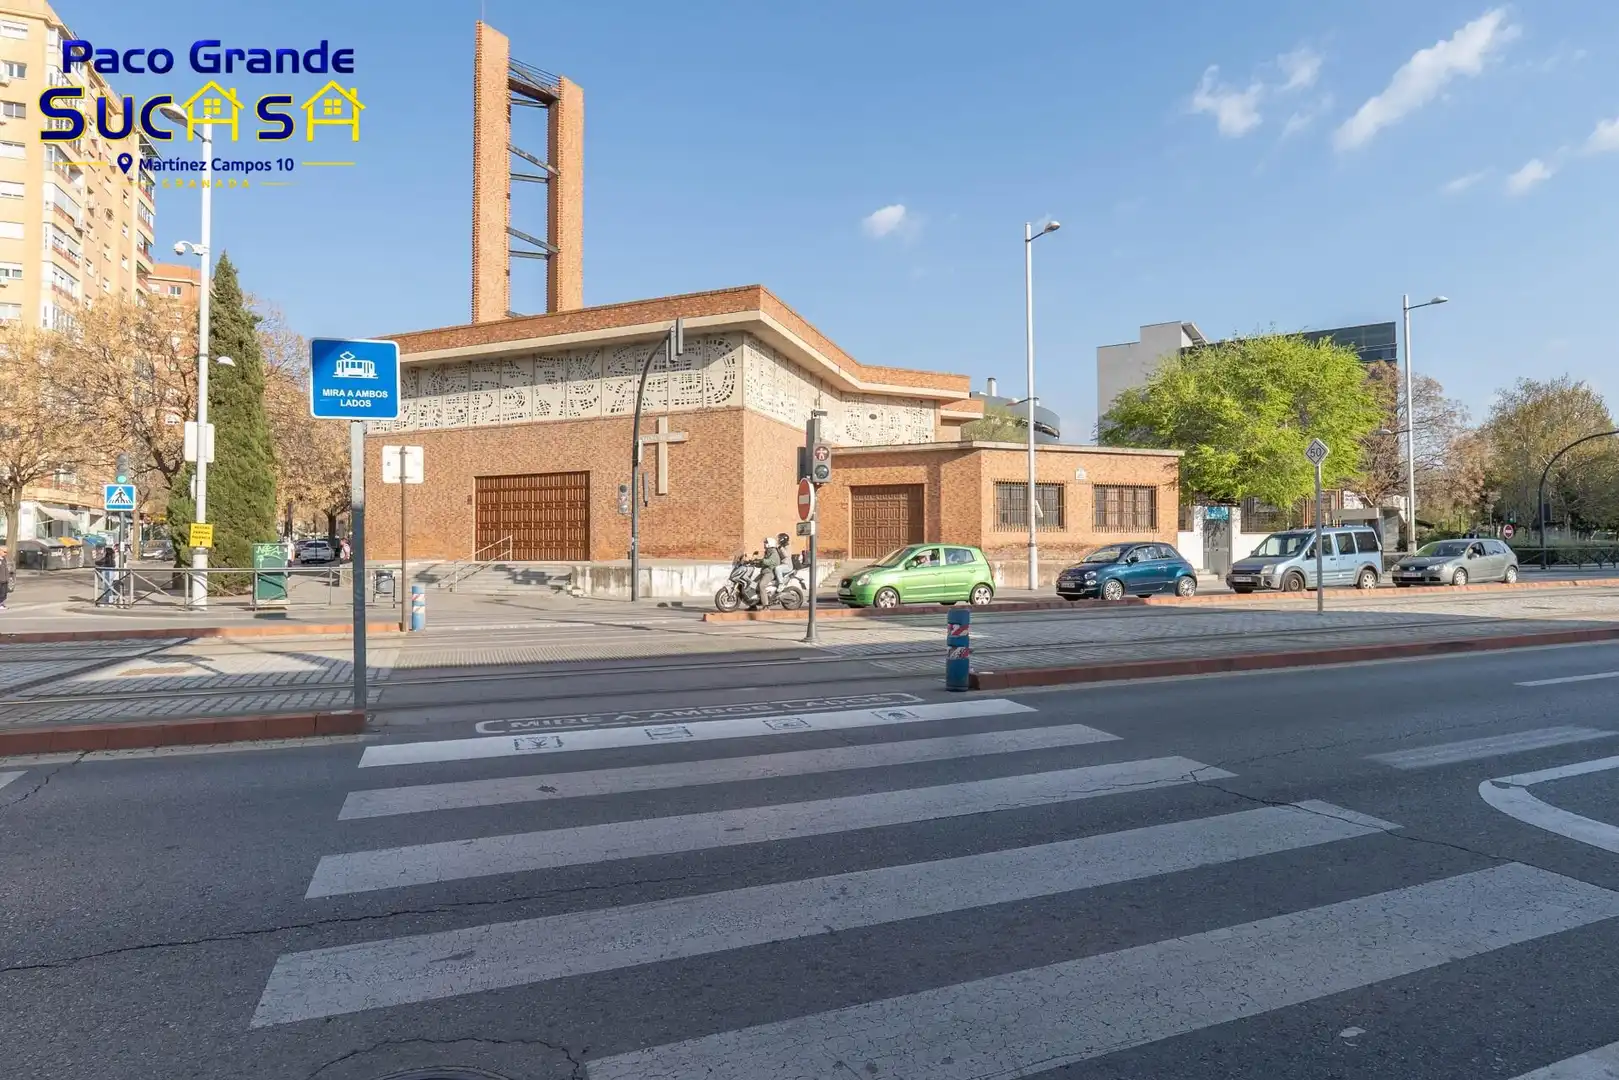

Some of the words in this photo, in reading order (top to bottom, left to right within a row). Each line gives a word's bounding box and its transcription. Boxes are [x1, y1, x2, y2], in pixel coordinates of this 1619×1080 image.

[322, 388, 346, 397] MIRA
[347, 389, 354, 398] A
[355, 389, 389, 398] AMBOS
[340, 399, 372, 408] LADOS
[1310, 447, 1322, 458] 50
[615, 713, 640, 722] A
[650, 703, 774, 719] AMBOS
[781, 695, 892, 709] LADOS
